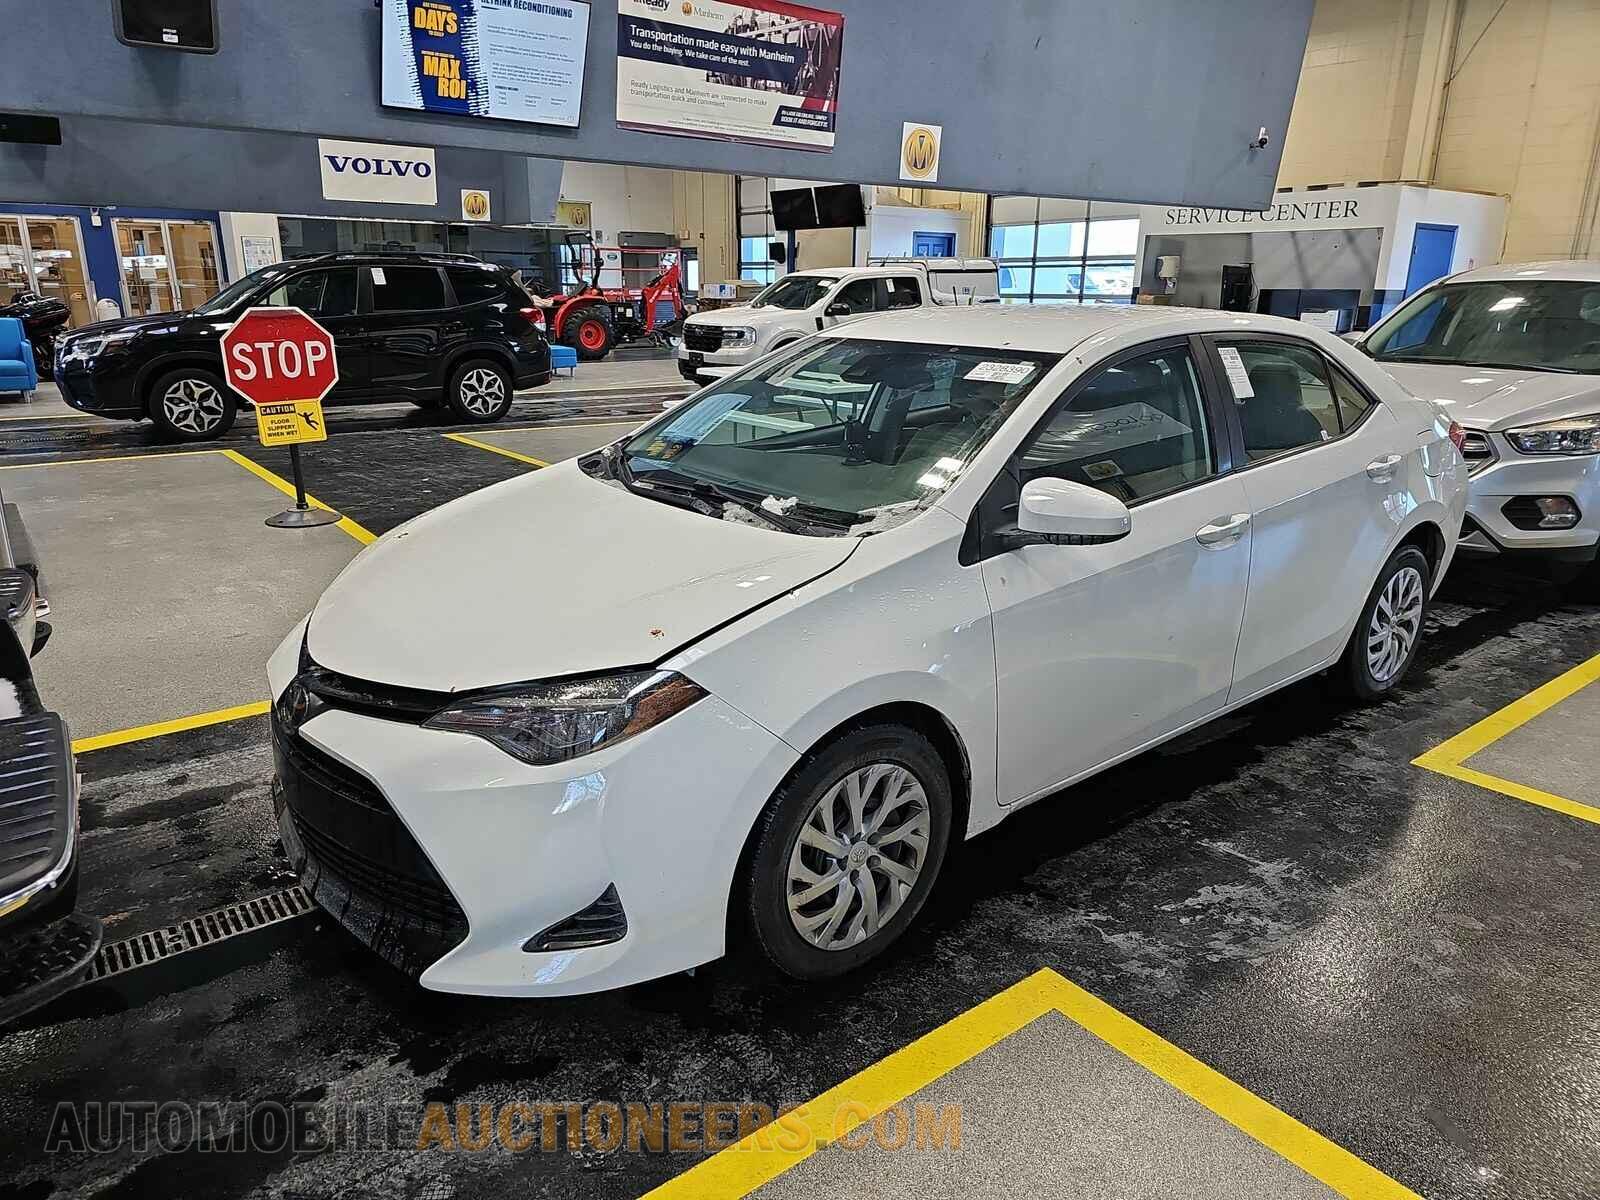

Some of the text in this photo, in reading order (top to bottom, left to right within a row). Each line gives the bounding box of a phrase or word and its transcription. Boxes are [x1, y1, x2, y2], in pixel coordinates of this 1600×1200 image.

[414, 7, 458, 34] DAYS
[481, 0, 573, 18] THINK RECONDITIONING
[694, 7, 724, 20] Manheim
[630, 25, 795, 64] Transportation made easy with Manheim
[630, 39, 642, 48] You
[643, 41, 651, 50] do
[652, 42, 662, 51] the
[685, 49, 695, 57] We
[695, 50, 708, 60] take
[709, 54, 720, 62] care
[721, 55, 729, 63] of
[728, 56, 738, 65] the
[423, 55, 461, 79] MAX
[437, 77, 466, 99] ROI
[631, 79, 648, 90] Ready
[649, 82, 674, 93] Logistics
[675, 87, 685, 95] and
[686, 88, 711, 98] Manheim
[720, 94, 747, 103] connected
[754, 98, 767, 106] make
[631, 89, 671, 102] transportation
[324, 155, 432, 178] VOLVO
[1165, 199, 1359, 225] SERVICE CENTER
[232, 340, 327, 381] STOP
[261, 405, 295, 415] CAUTION
